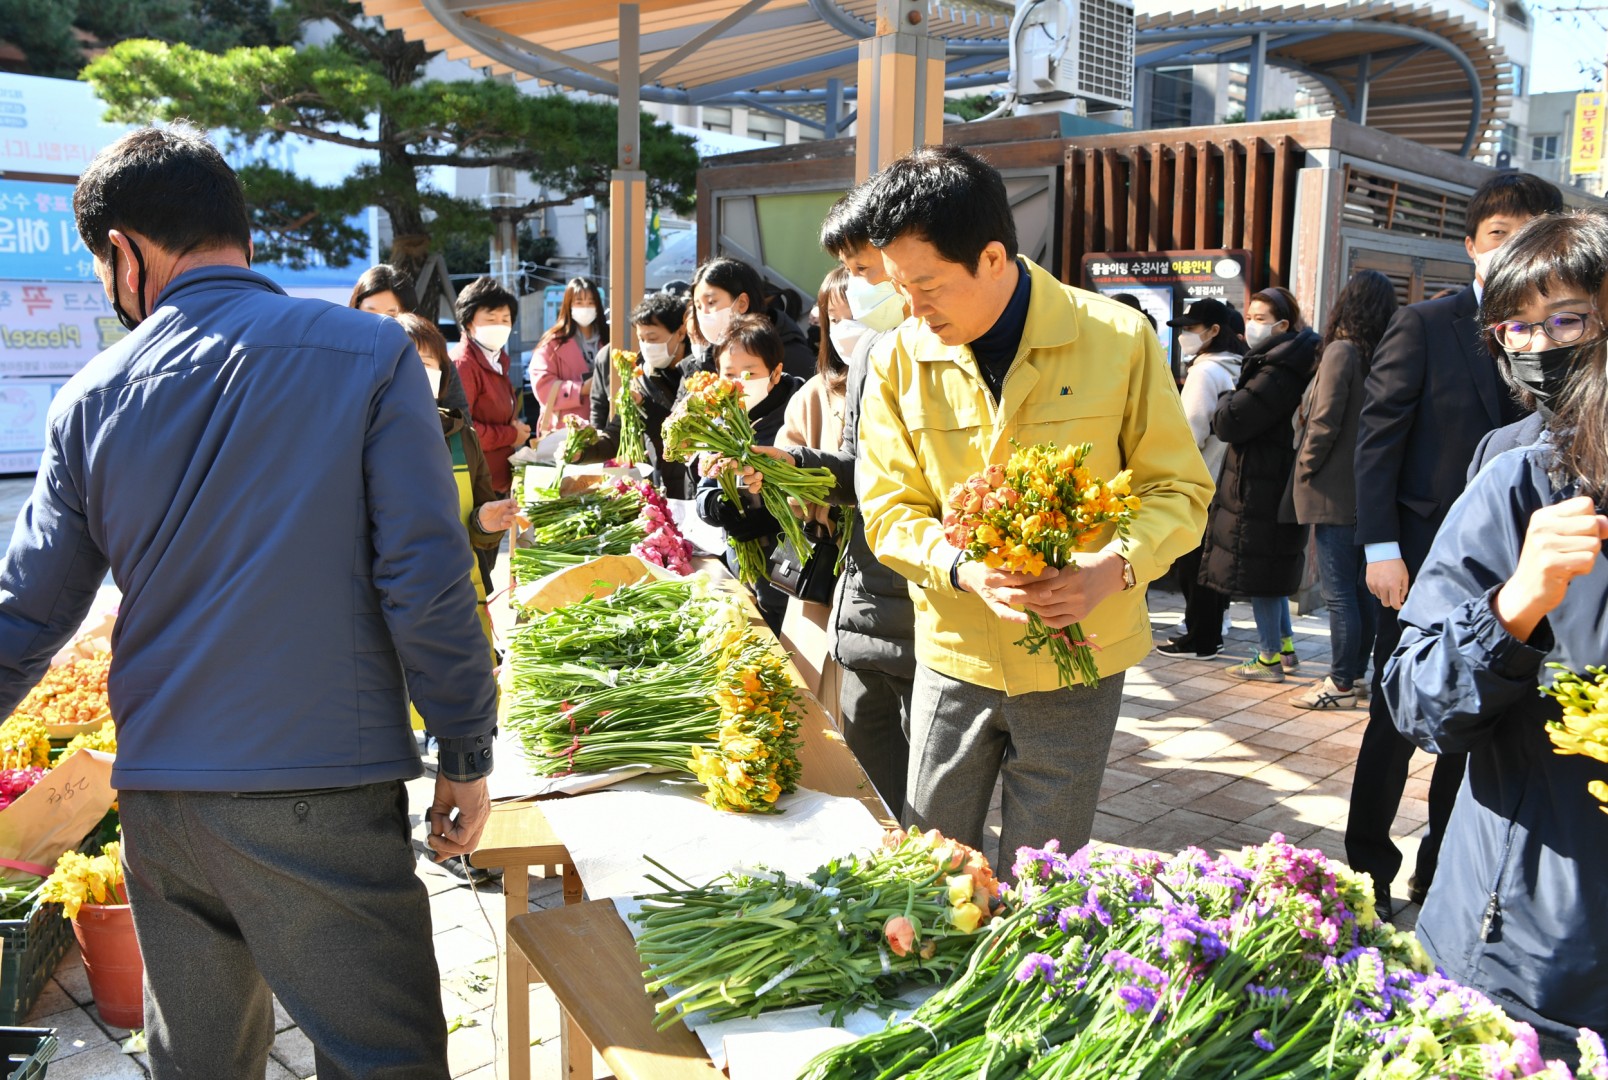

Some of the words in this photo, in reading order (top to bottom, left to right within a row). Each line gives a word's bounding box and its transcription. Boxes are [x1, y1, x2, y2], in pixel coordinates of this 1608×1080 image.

[1580, 110, 1598, 159] 부동산
[1092, 263, 1128, 275] 물놀이형
[1131, 262, 1169, 275] 수경시설
[1172, 260, 1212, 275] 이용안내
